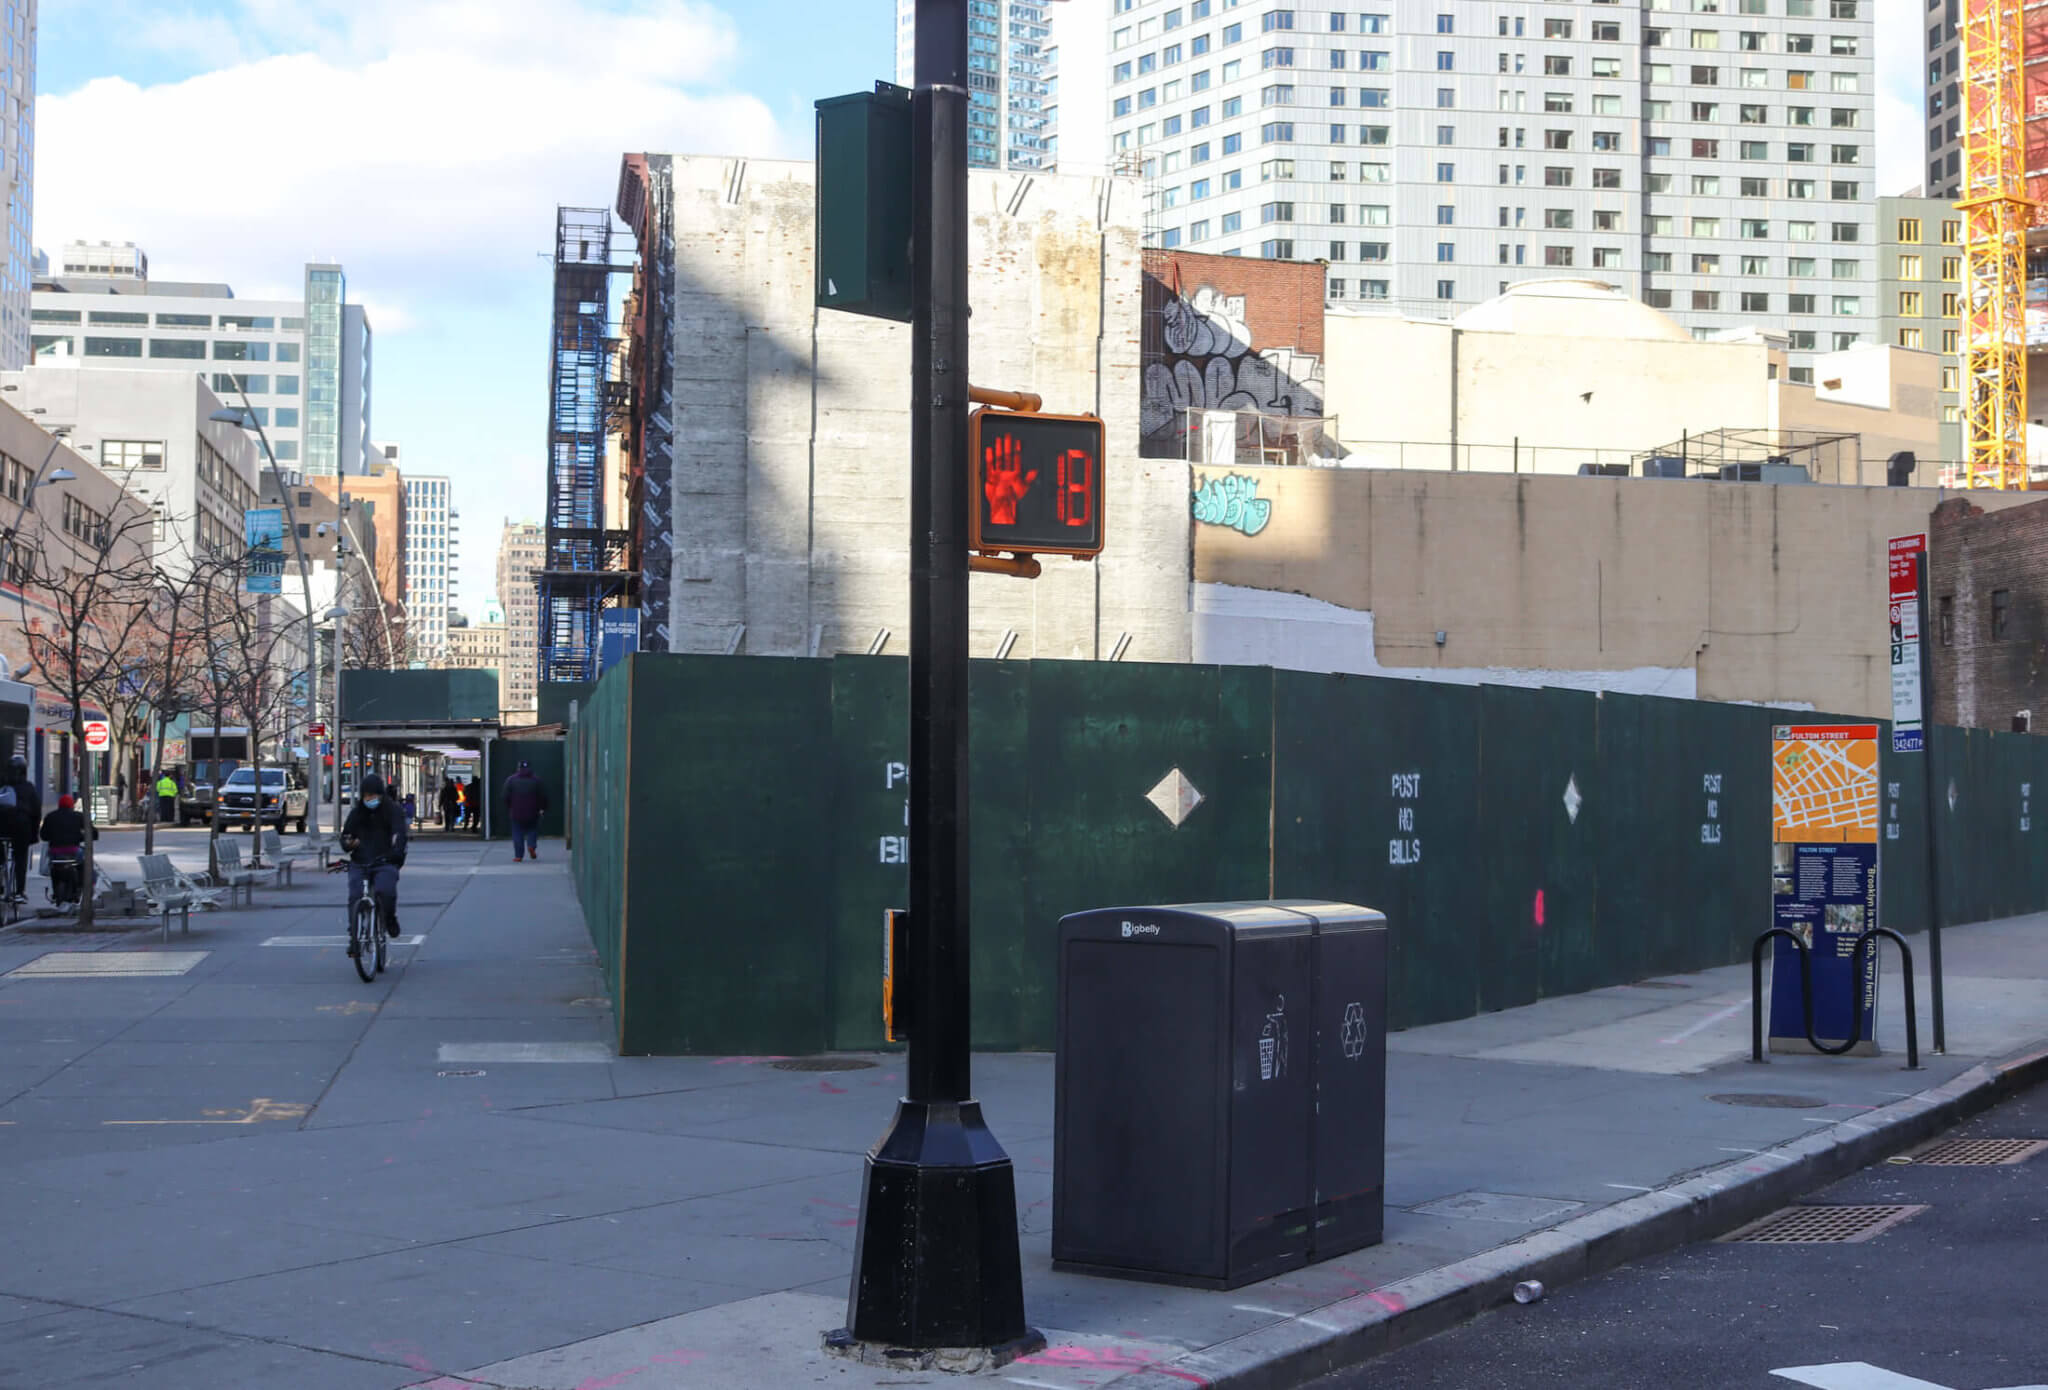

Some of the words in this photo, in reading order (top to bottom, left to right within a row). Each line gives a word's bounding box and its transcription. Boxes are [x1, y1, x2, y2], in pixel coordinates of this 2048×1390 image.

[1057, 450, 1092, 526] 18
[1893, 646, 1900, 663] 2
[1792, 732, 1819, 740] FULTON
[1821, 732, 1848, 740] STREET
[1392, 774, 1420, 798] POST
[1399, 807, 1413, 831] NO
[1389, 839, 1420, 864] BILLS
[1122, 921, 1160, 937] Bigbelly
